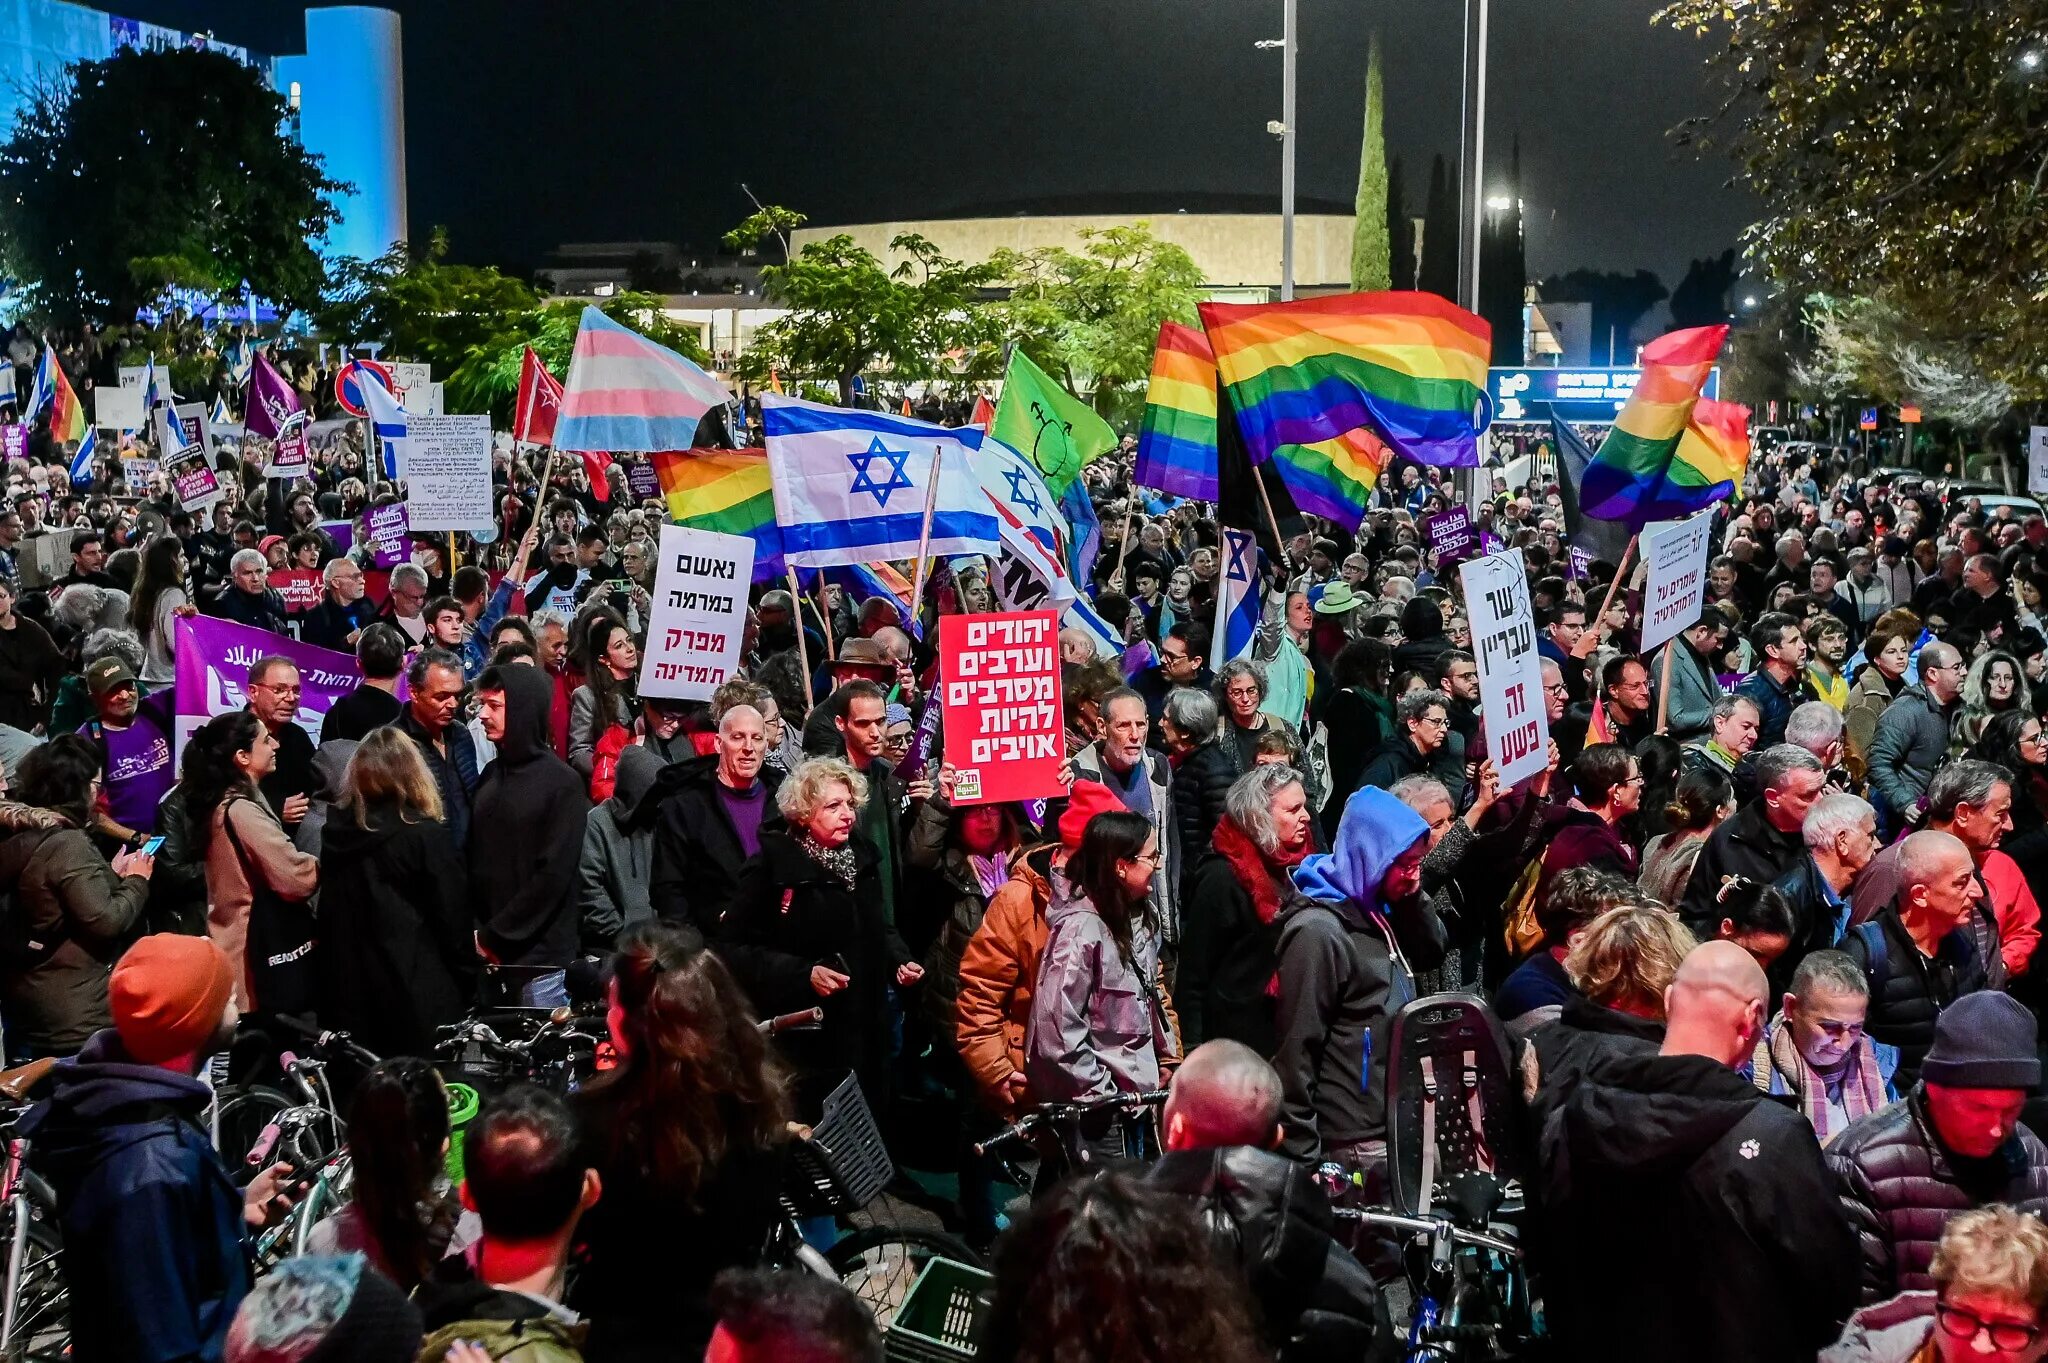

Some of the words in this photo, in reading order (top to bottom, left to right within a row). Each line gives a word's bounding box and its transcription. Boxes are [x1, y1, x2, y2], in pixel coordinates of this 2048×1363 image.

[1434, 525, 1454, 536] הבית
[1457, 536, 1468, 545] של
[1436, 541, 1455, 554] כולנו
[676, 554, 736, 580] נאשם
[1670, 568, 1698, 595] שומרים
[668, 590, 734, 614] במרמה
[1486, 584, 1514, 621] שר
[1657, 582, 1668, 602] על
[1653, 590, 1697, 626] הדמוקרטיה
[968, 618, 1050, 647] יהודים
[959, 647, 1053, 676] וערבים
[1481, 621, 1532, 676] עבריין
[308, 668, 352, 688] הזאת
[948, 676, 1054, 706] מסרבים
[1504, 682, 1526, 719] זה
[980, 700, 1056, 734] להיות
[972, 734, 1058, 764] אויבים
[1501, 720, 1540, 767] פשע
